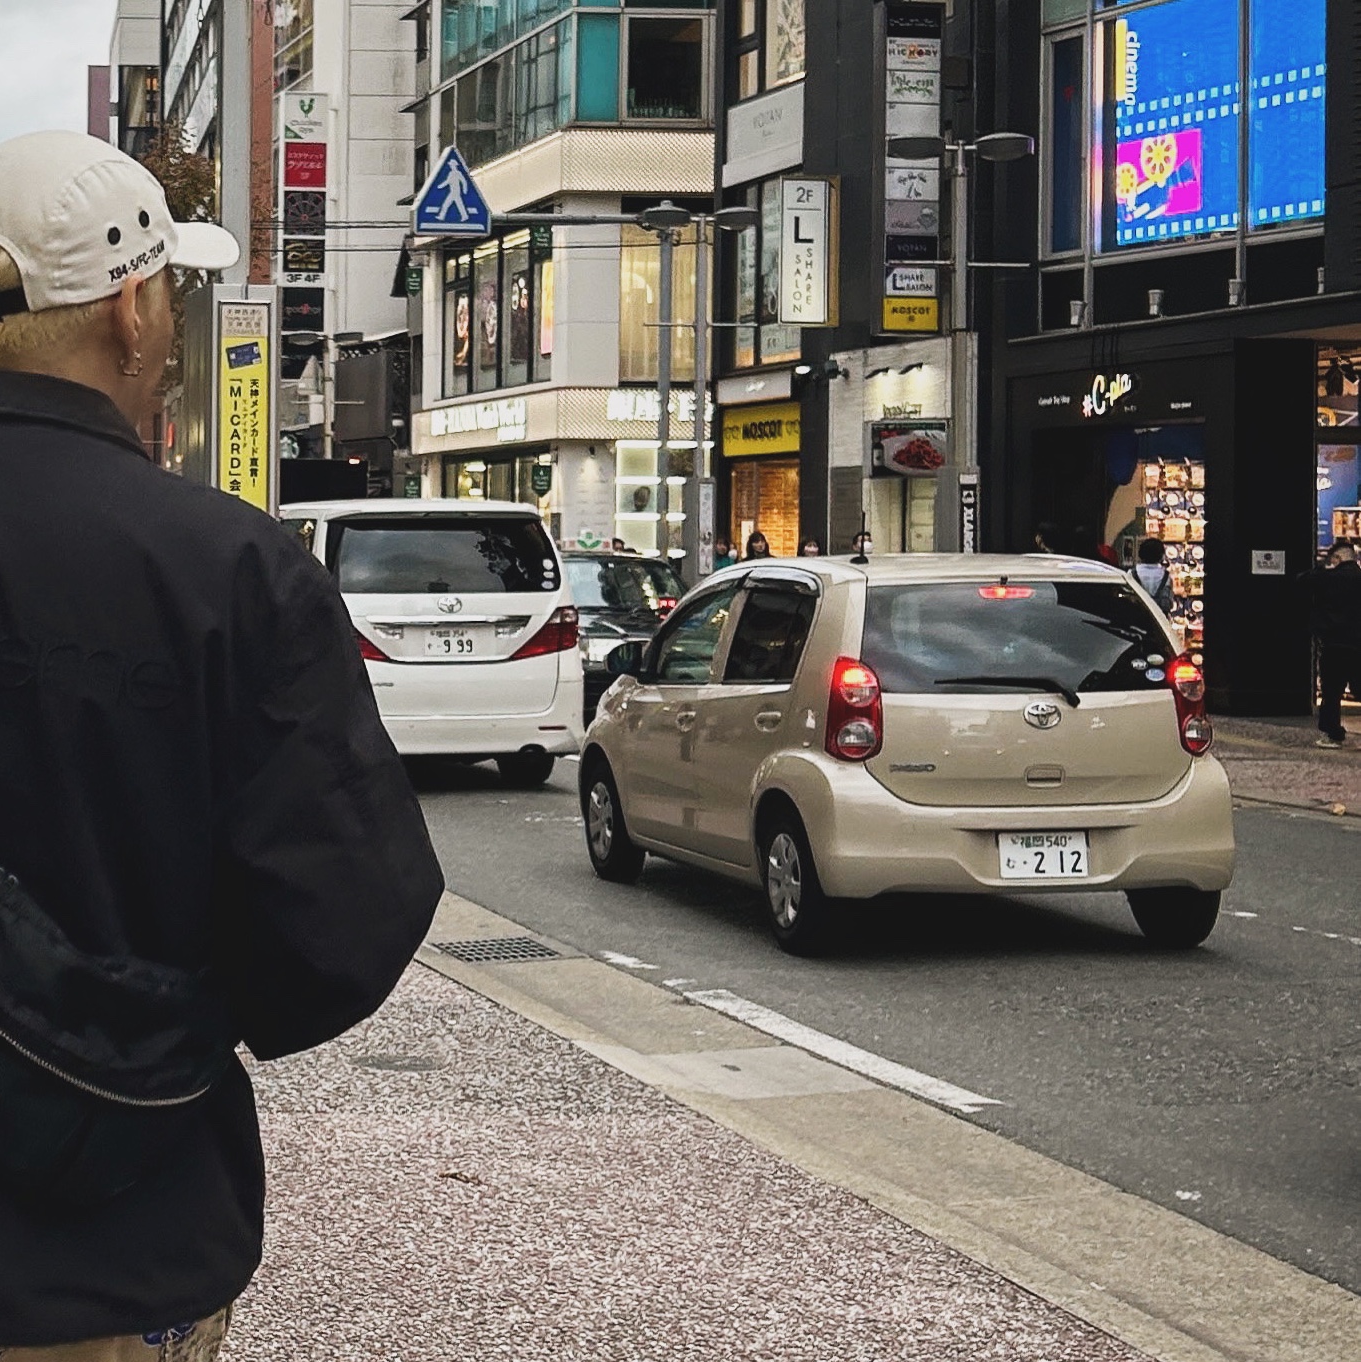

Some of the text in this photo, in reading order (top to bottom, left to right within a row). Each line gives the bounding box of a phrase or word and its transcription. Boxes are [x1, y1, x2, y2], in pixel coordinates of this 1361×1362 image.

[796, 187, 814, 203] 2F
[794, 216, 814, 243] L
[793, 254, 802, 313] SALON
